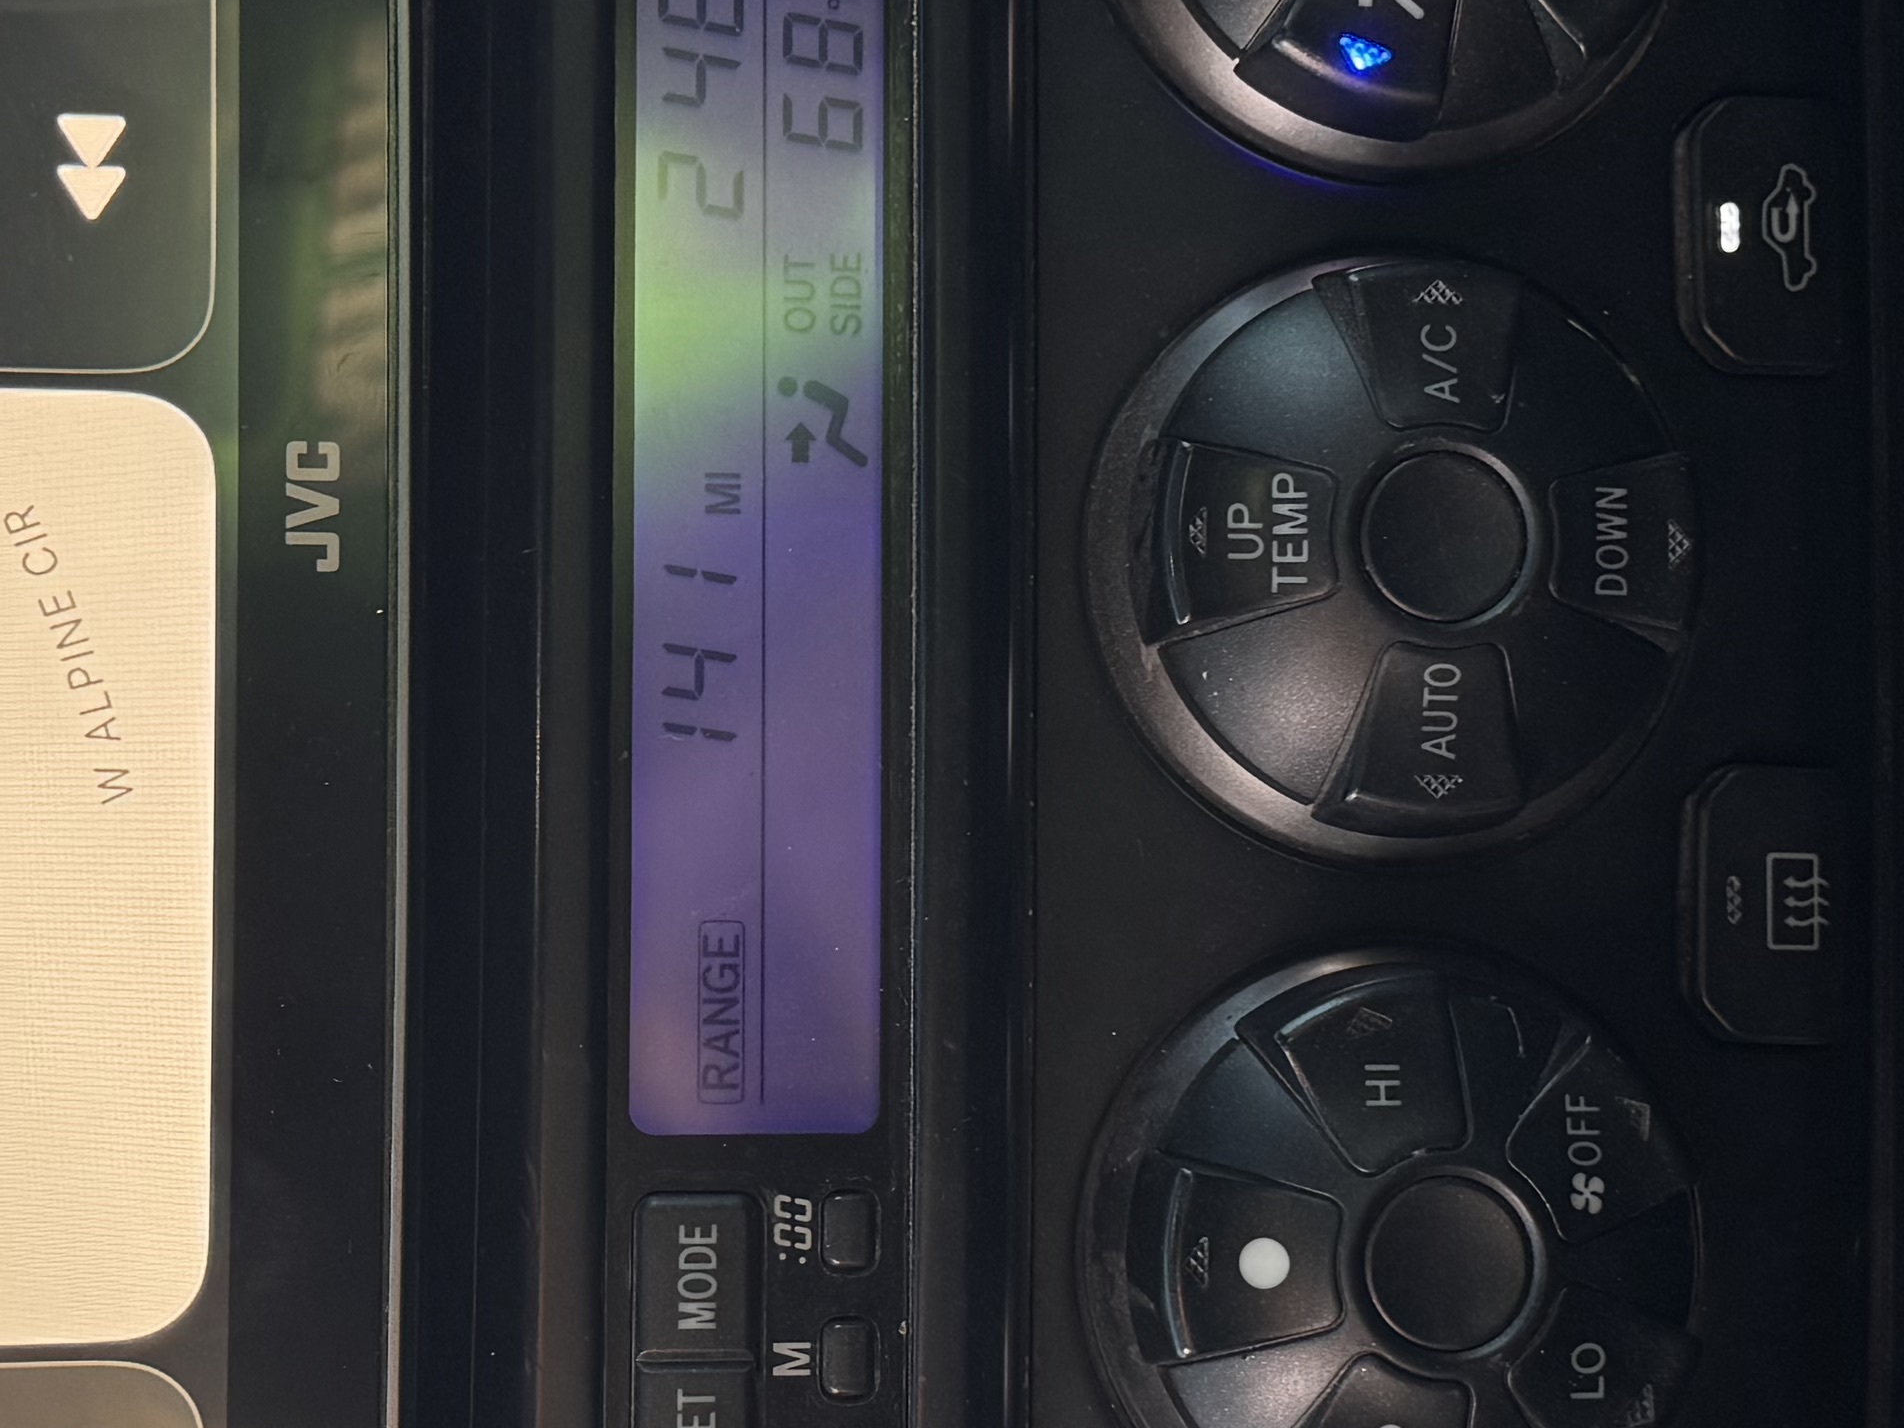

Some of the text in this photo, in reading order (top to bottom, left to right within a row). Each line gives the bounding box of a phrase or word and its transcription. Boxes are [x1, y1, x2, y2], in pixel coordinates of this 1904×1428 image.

[783, 253, 816, 334] OUT
[829, 252, 862, 338] SIDE
[1420, 324, 1459, 404] A/C
[284, 439, 343, 573] JVC
[1227, 503, 1266, 559] UP
[1270, 472, 1312, 594] TEMP
[1594, 485, 1630, 597] DOWN
[662, 471, 743, 743] 141 MI
[3, 504, 133, 805] W ALPINE CIR
[1421, 662, 1463, 760] AUTO
[699, 934, 743, 1092] RANGE
[1364, 1062, 1402, 1107] HI
[1565, 1094, 1602, 1167] OFF
[774, 1193, 812, 1264] :00
[678, 1224, 719, 1330] MODE
[773, 1341, 811, 1375] M
[1570, 1342, 1607, 1399] LO
